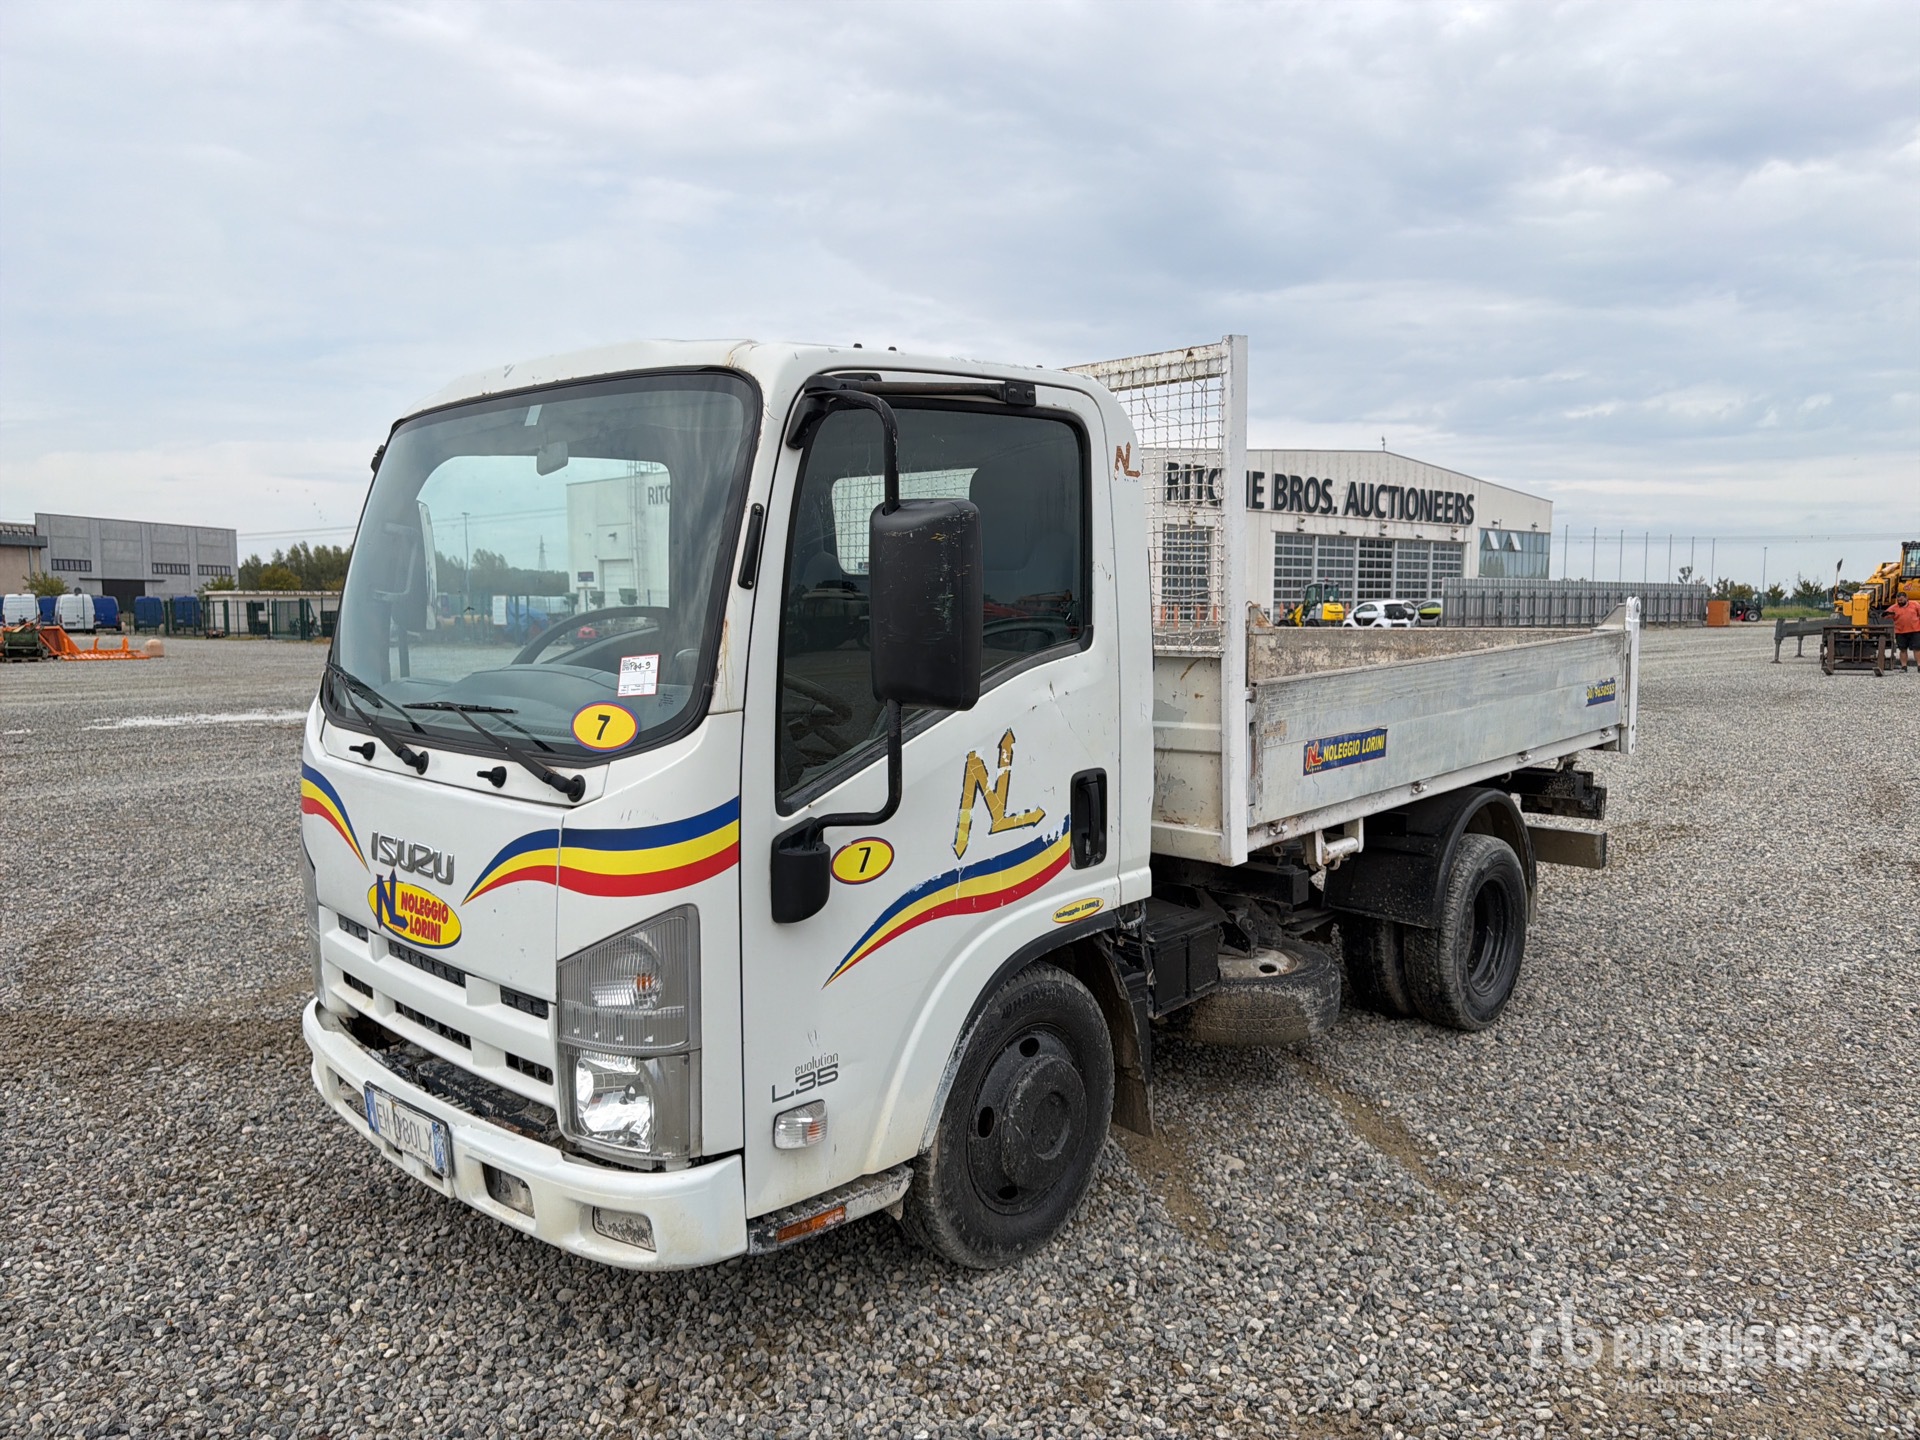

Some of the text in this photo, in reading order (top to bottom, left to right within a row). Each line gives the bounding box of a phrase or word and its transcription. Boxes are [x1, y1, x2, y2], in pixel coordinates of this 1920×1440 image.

[1163, 462, 1475, 526] RITCE BROS. AUCTIONEERS
[596, 714, 611, 740] 7
[1323, 734, 1385, 762] NOLEGGIO LORINI
[371, 830, 455, 886] ISUZU
[858, 846, 872, 873] 7
[401, 891, 449, 924] NOLEGGIO
[1055, 906, 1080, 919] Noleggio
[409, 914, 442, 943] LORINI
[794, 1052, 839, 1076] evolution
[771, 1062, 839, 1103] L35
